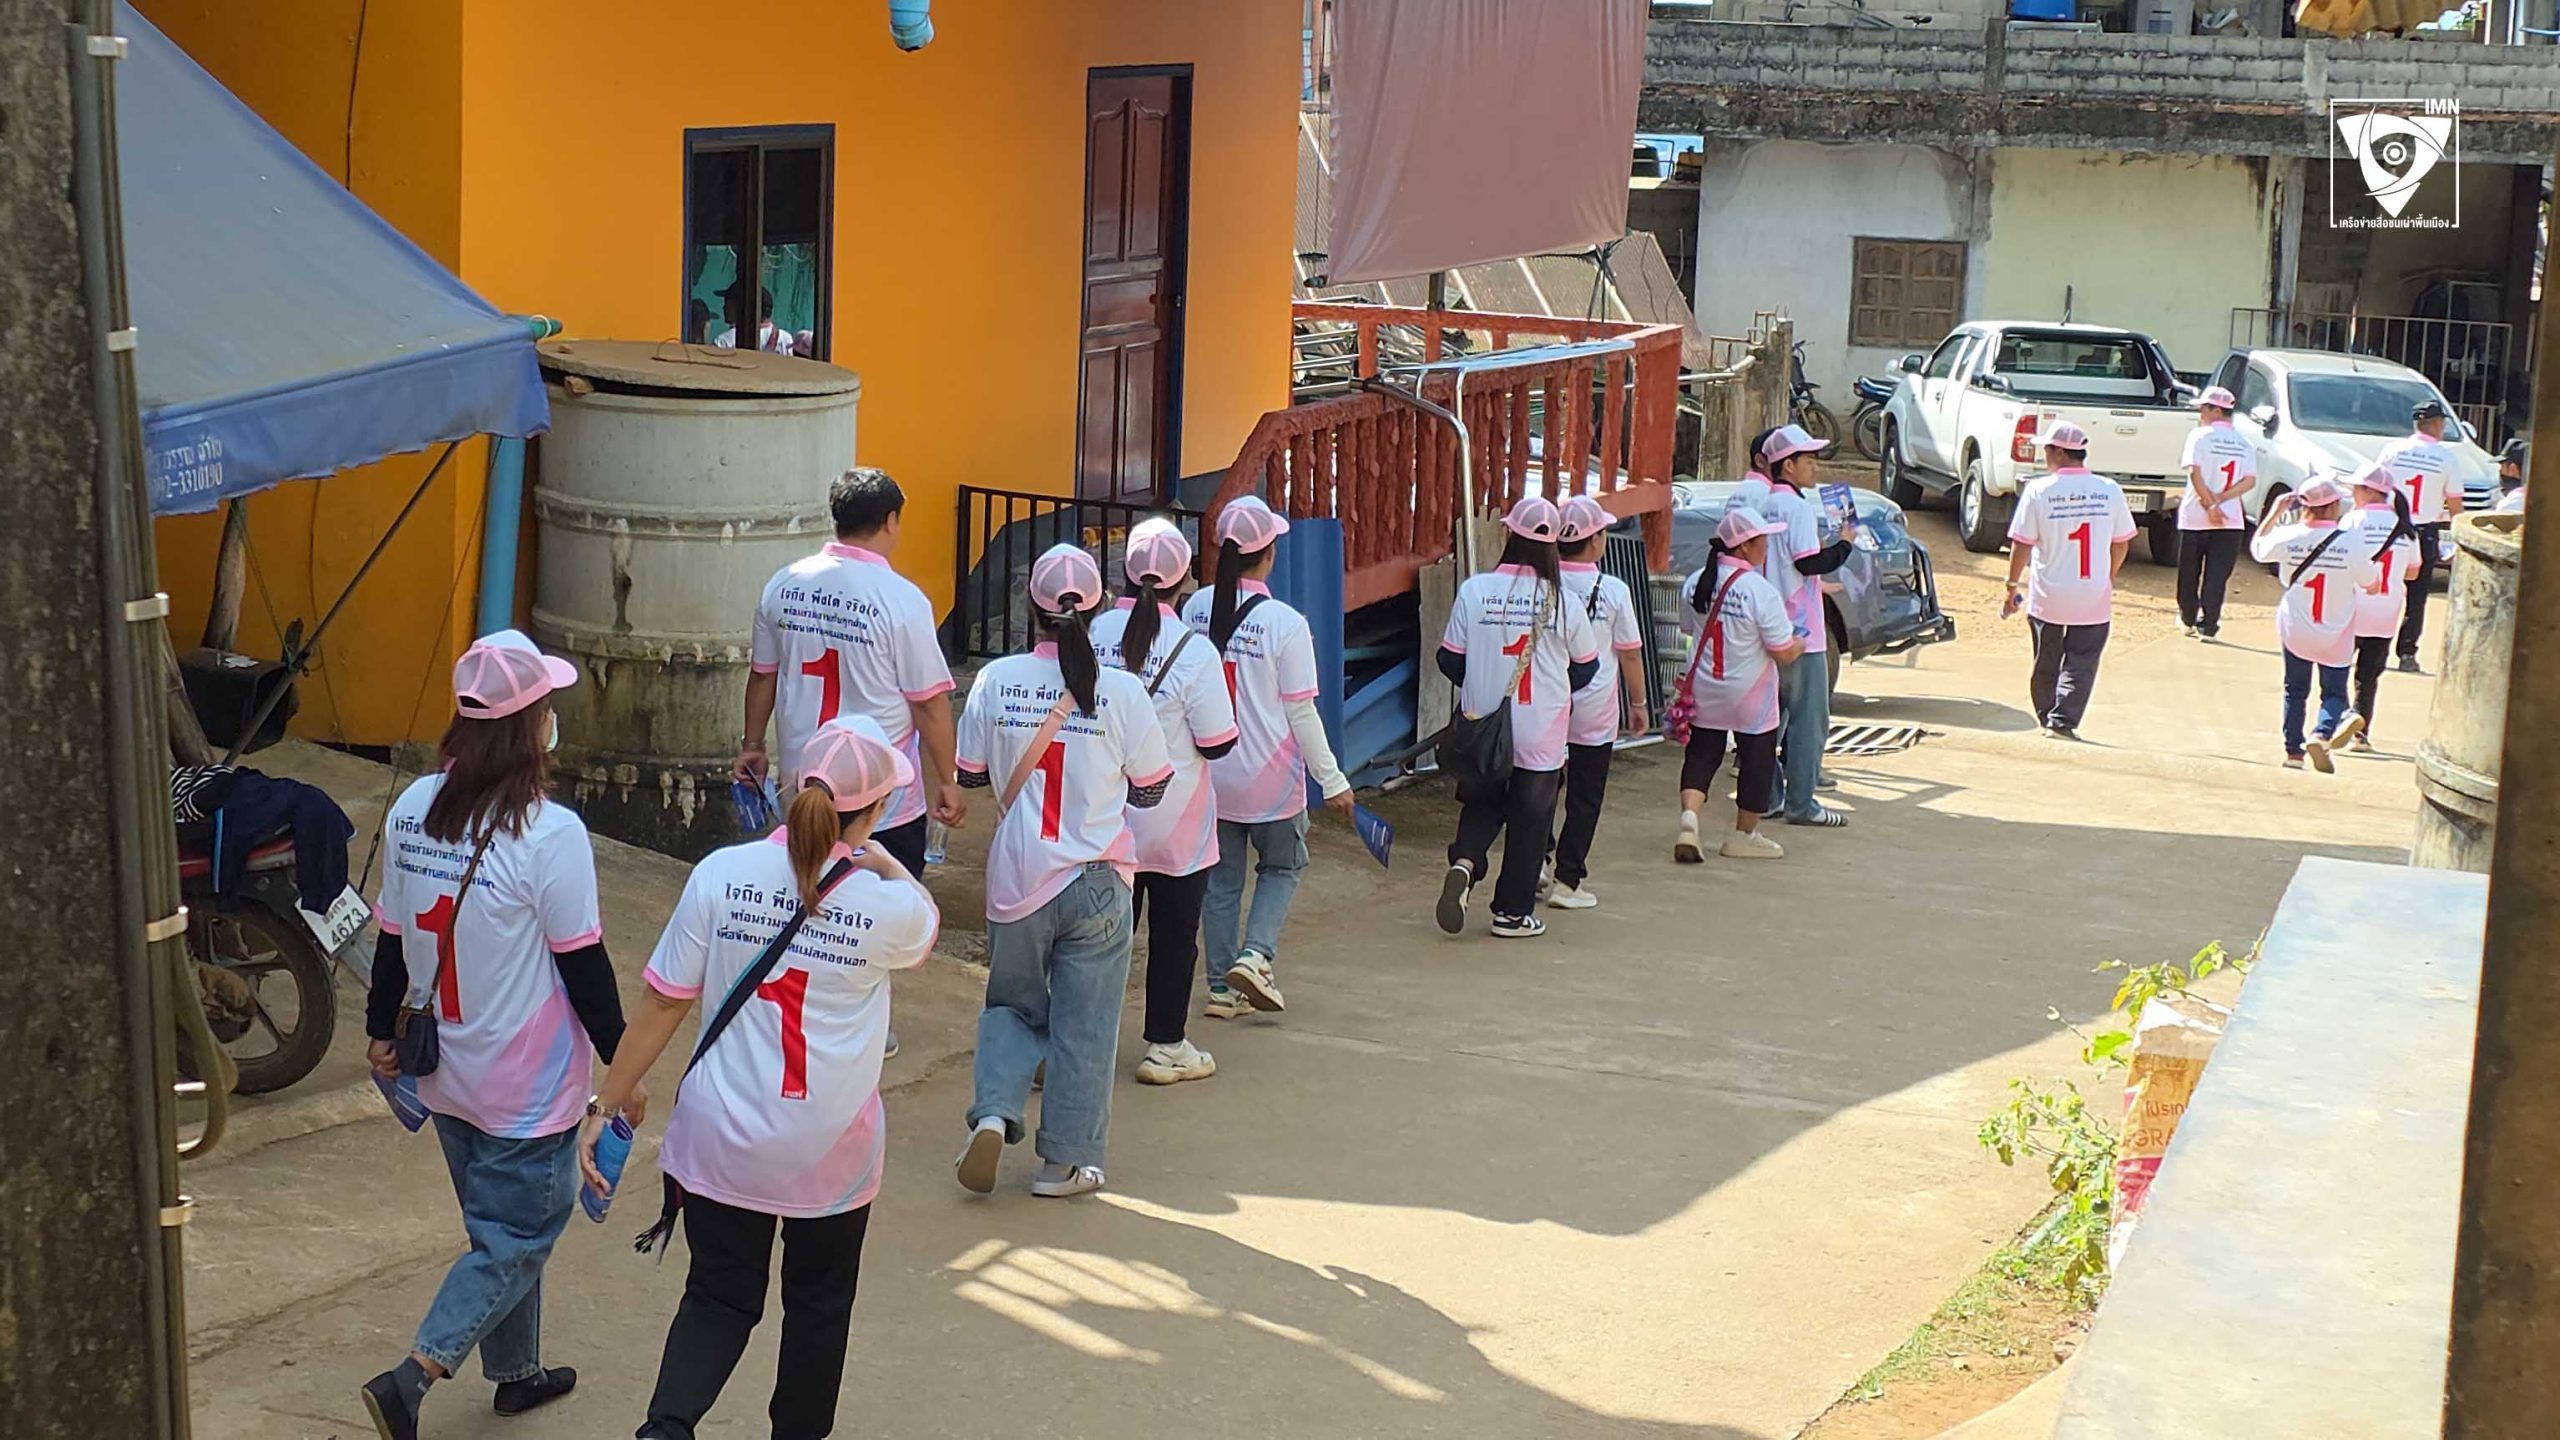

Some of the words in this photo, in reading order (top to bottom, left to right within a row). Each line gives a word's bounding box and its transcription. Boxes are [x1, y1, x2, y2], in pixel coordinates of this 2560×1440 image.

[2221, 461, 2236, 491] 1
[2405, 474, 2424, 515] 1
[2068, 522, 2091, 579] 1
[2304, 572, 2326, 624] 1
[802, 647, 841, 730] 1
[1000, 684, 1029, 699] ใจถึง
[1503, 634, 1532, 705] 1
[1035, 740, 1066, 843] 1
[331, 907, 366, 945] 4673
[725, 883, 763, 904] ใจถึง
[823, 907, 873, 930] จริงใจ
[415, 894, 463, 1024] 1
[757, 967, 809, 1100] 1
